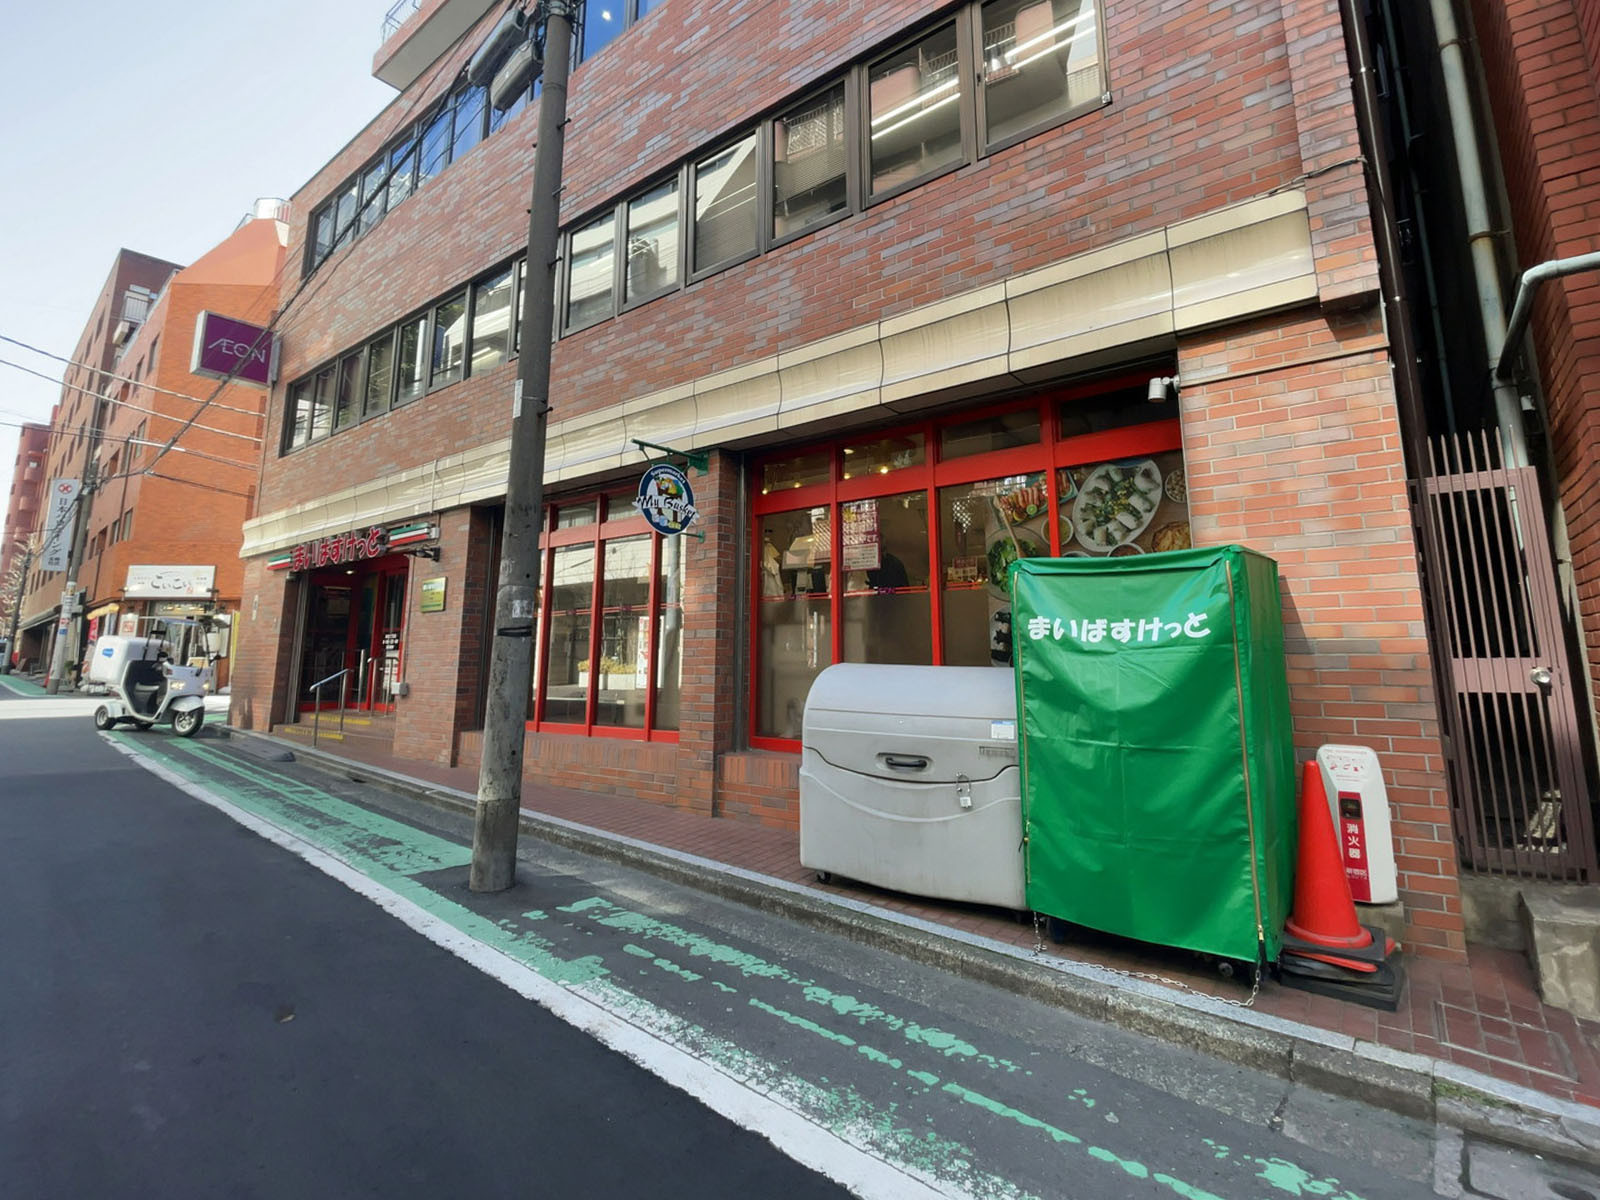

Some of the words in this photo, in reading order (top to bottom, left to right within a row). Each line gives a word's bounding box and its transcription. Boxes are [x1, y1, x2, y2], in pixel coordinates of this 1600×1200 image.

[637, 495, 659, 510] My
[664, 497, 696, 518] Basket
[291, 527, 382, 571] まいばすけっと
[1028, 611, 1211, 643] まいばすけっと
[1346, 823, 1361, 859] 消火器
